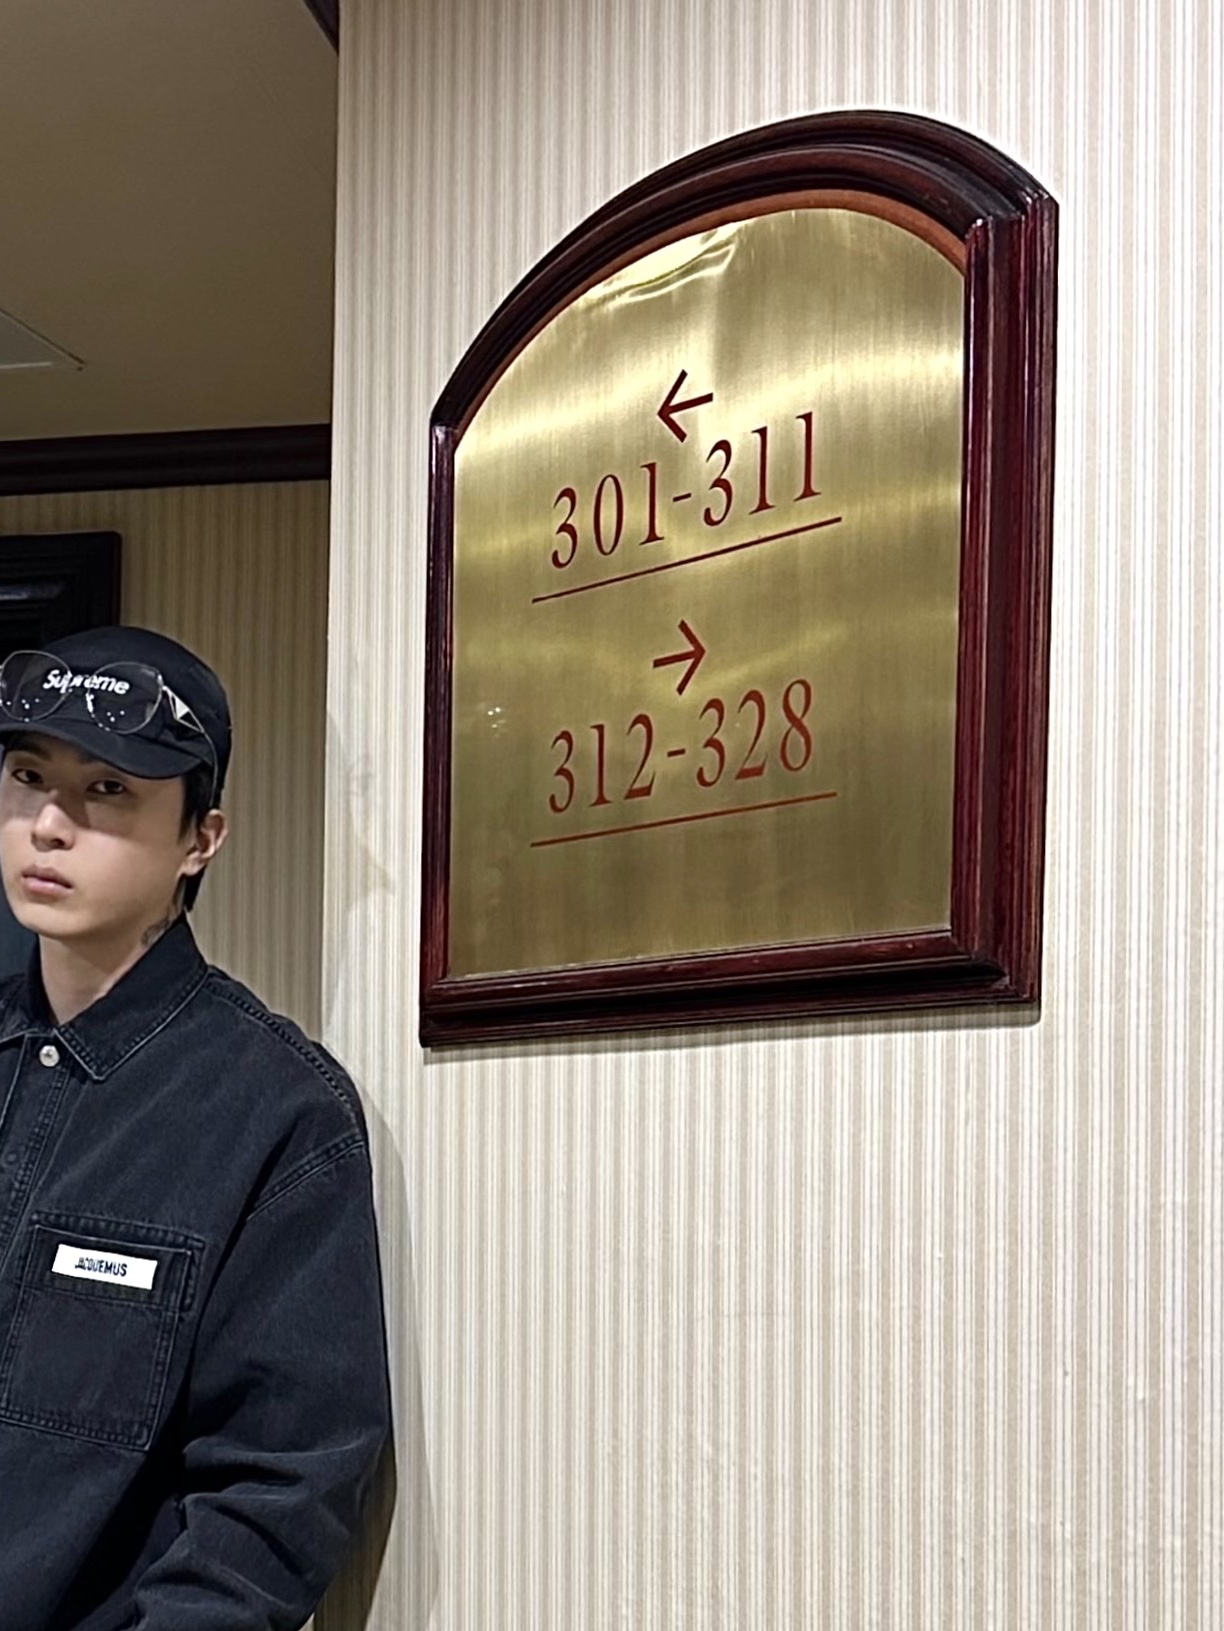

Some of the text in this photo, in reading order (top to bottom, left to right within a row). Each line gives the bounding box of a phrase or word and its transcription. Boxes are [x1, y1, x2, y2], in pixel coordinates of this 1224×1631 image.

[550, 411, 822, 569] 301-311
[43, 669, 130, 695] Supreme
[548, 679, 813, 814] 312-328
